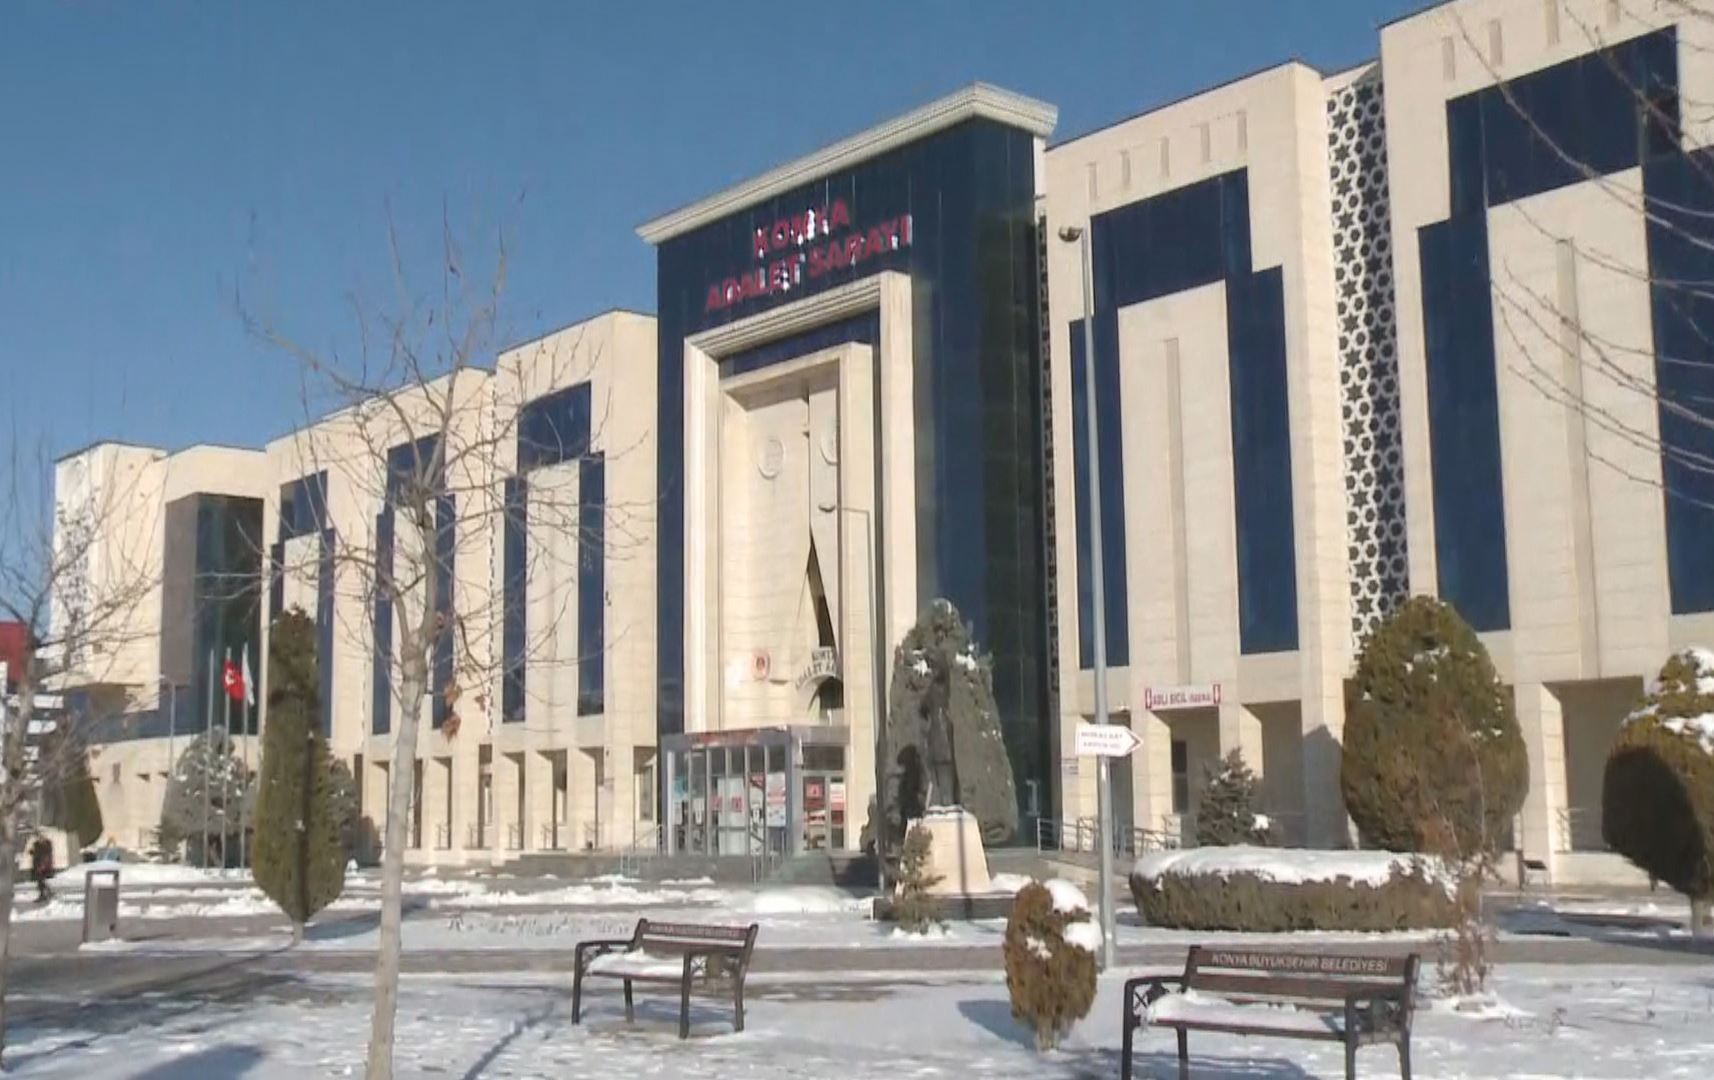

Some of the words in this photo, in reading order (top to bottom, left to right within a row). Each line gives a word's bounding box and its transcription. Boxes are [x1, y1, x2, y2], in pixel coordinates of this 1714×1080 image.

[753, 199, 849, 258] KONYA
[705, 253, 805, 309] ADALET
[807, 214, 913, 278] SARAYI
[1211, 953, 1247, 966] KONYA
